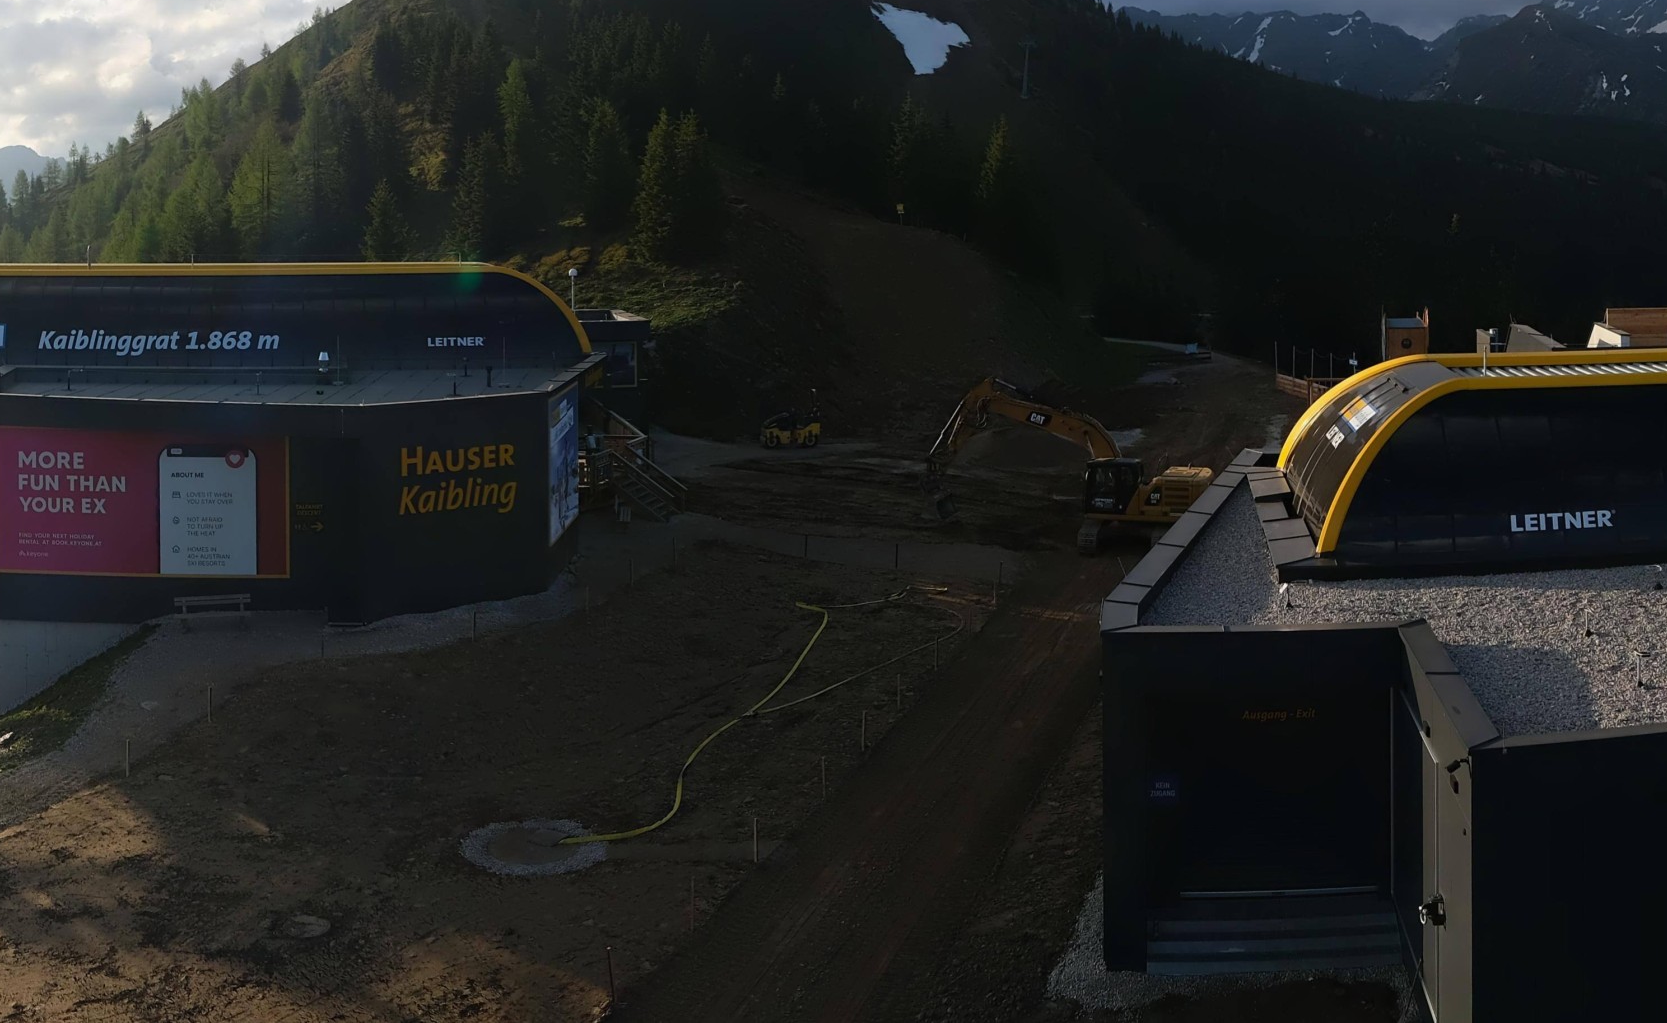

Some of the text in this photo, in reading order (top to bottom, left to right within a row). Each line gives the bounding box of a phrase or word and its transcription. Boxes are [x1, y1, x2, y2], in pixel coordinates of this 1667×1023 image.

[38, 329, 280, 357] Kaiblinggrat 1.868 m
[427, 336, 486, 348] LEITNER
[1030, 412, 1046, 425] CAT
[17, 450, 85, 470] MORE
[400, 443, 516, 478] HAUSER
[17, 473, 127, 493] FUN THAN
[19, 496, 107, 515] YOUR EX
[398, 477, 518, 516] Kaibling
[1510, 509, 1616, 533] LEITNER
[1241, 709, 1288, 722] Ausgang
[1295, 707, 1317, 719] Exit
[1155, 781, 1171, 789] KEIN
